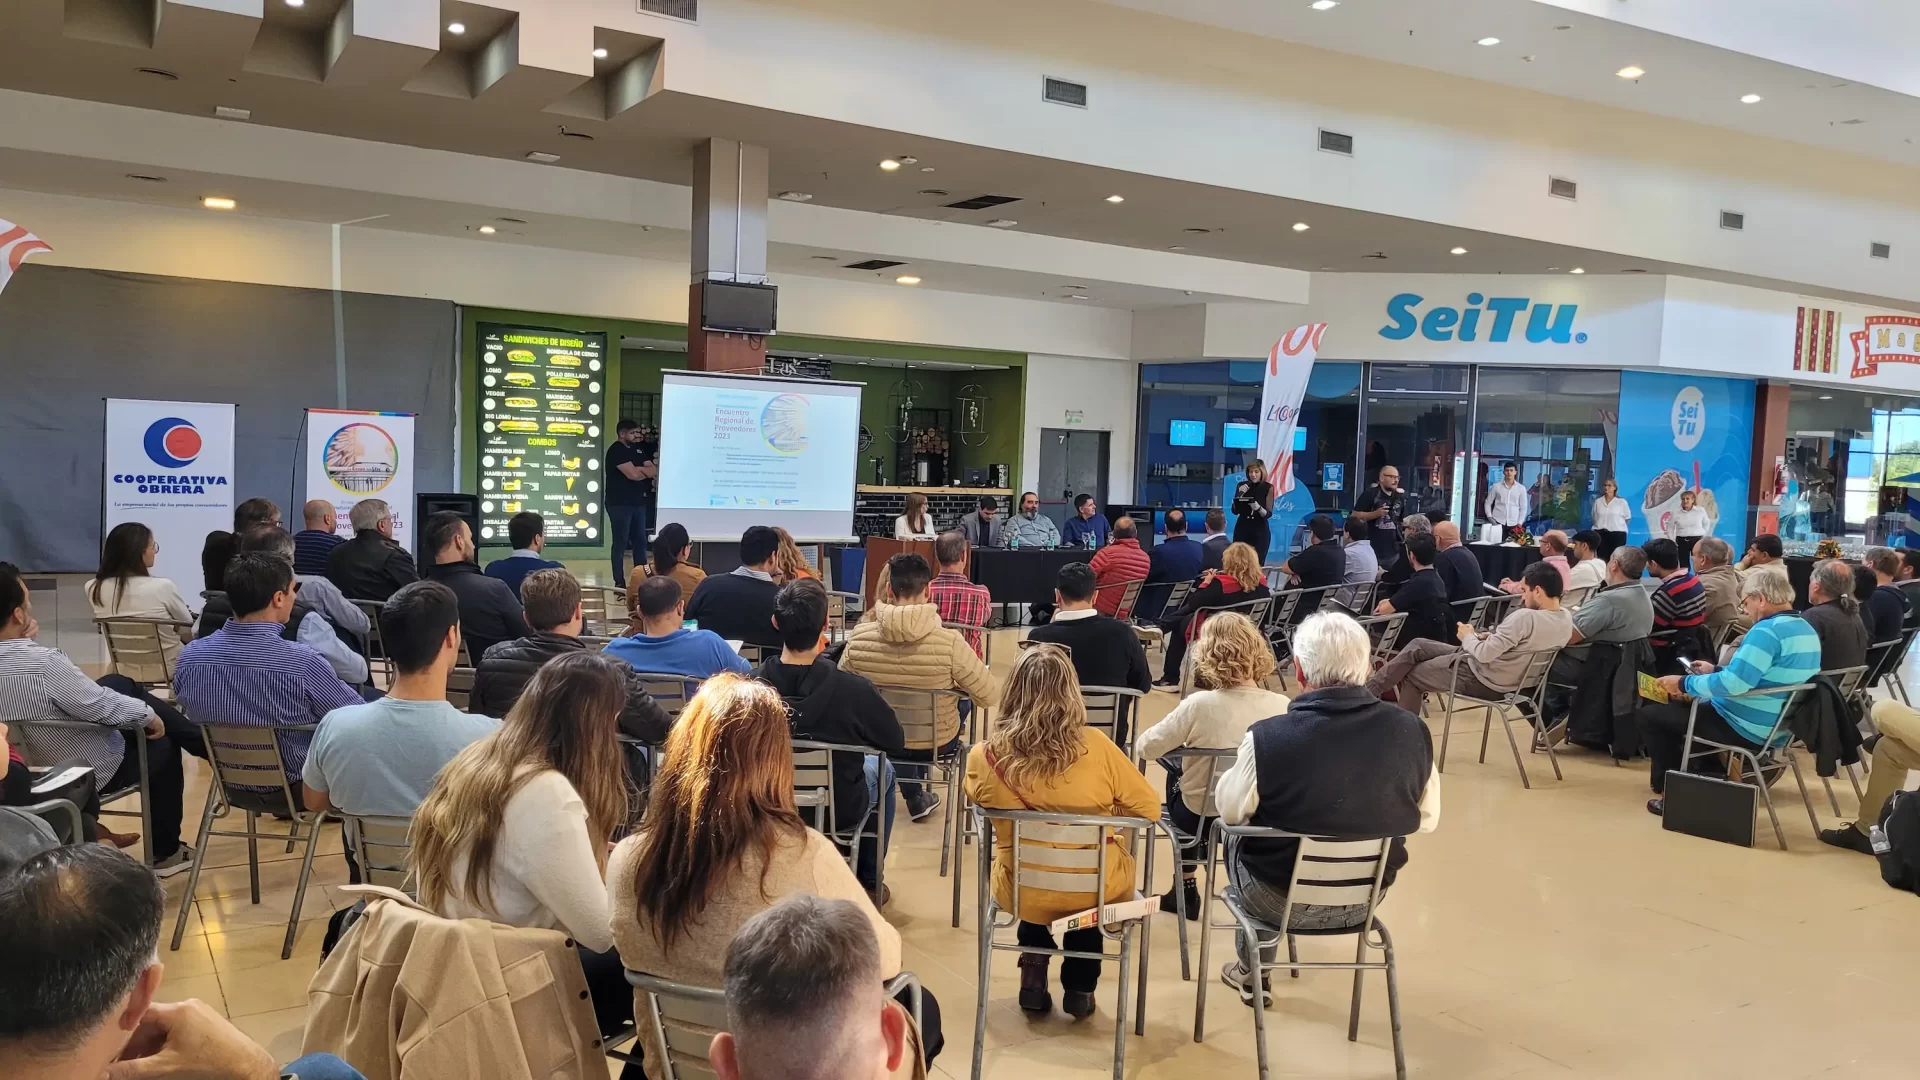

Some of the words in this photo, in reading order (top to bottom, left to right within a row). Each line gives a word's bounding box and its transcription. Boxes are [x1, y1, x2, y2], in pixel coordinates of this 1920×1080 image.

[1378, 292, 1578, 343] SeiTu
[503, 334, 549, 345] SANDWICHES
[550, 338, 559, 346] DE
[560, 338, 584, 348] DISEÑO
[715, 408, 750, 416] Encuentro
[1679, 401, 1699, 419] Sei
[715, 416, 744, 425] Regional
[745, 417, 754, 425] de
[714, 424, 757, 433] Proveedores
[1678, 419, 1696, 436] Tu
[714, 432, 731, 440] 2023
[1058, 435, 1065, 445] 7
[527, 437, 557, 447] COMBOS
[113, 474, 228, 485] COOPERATIVA
[138, 484, 205, 495] OBRERA
